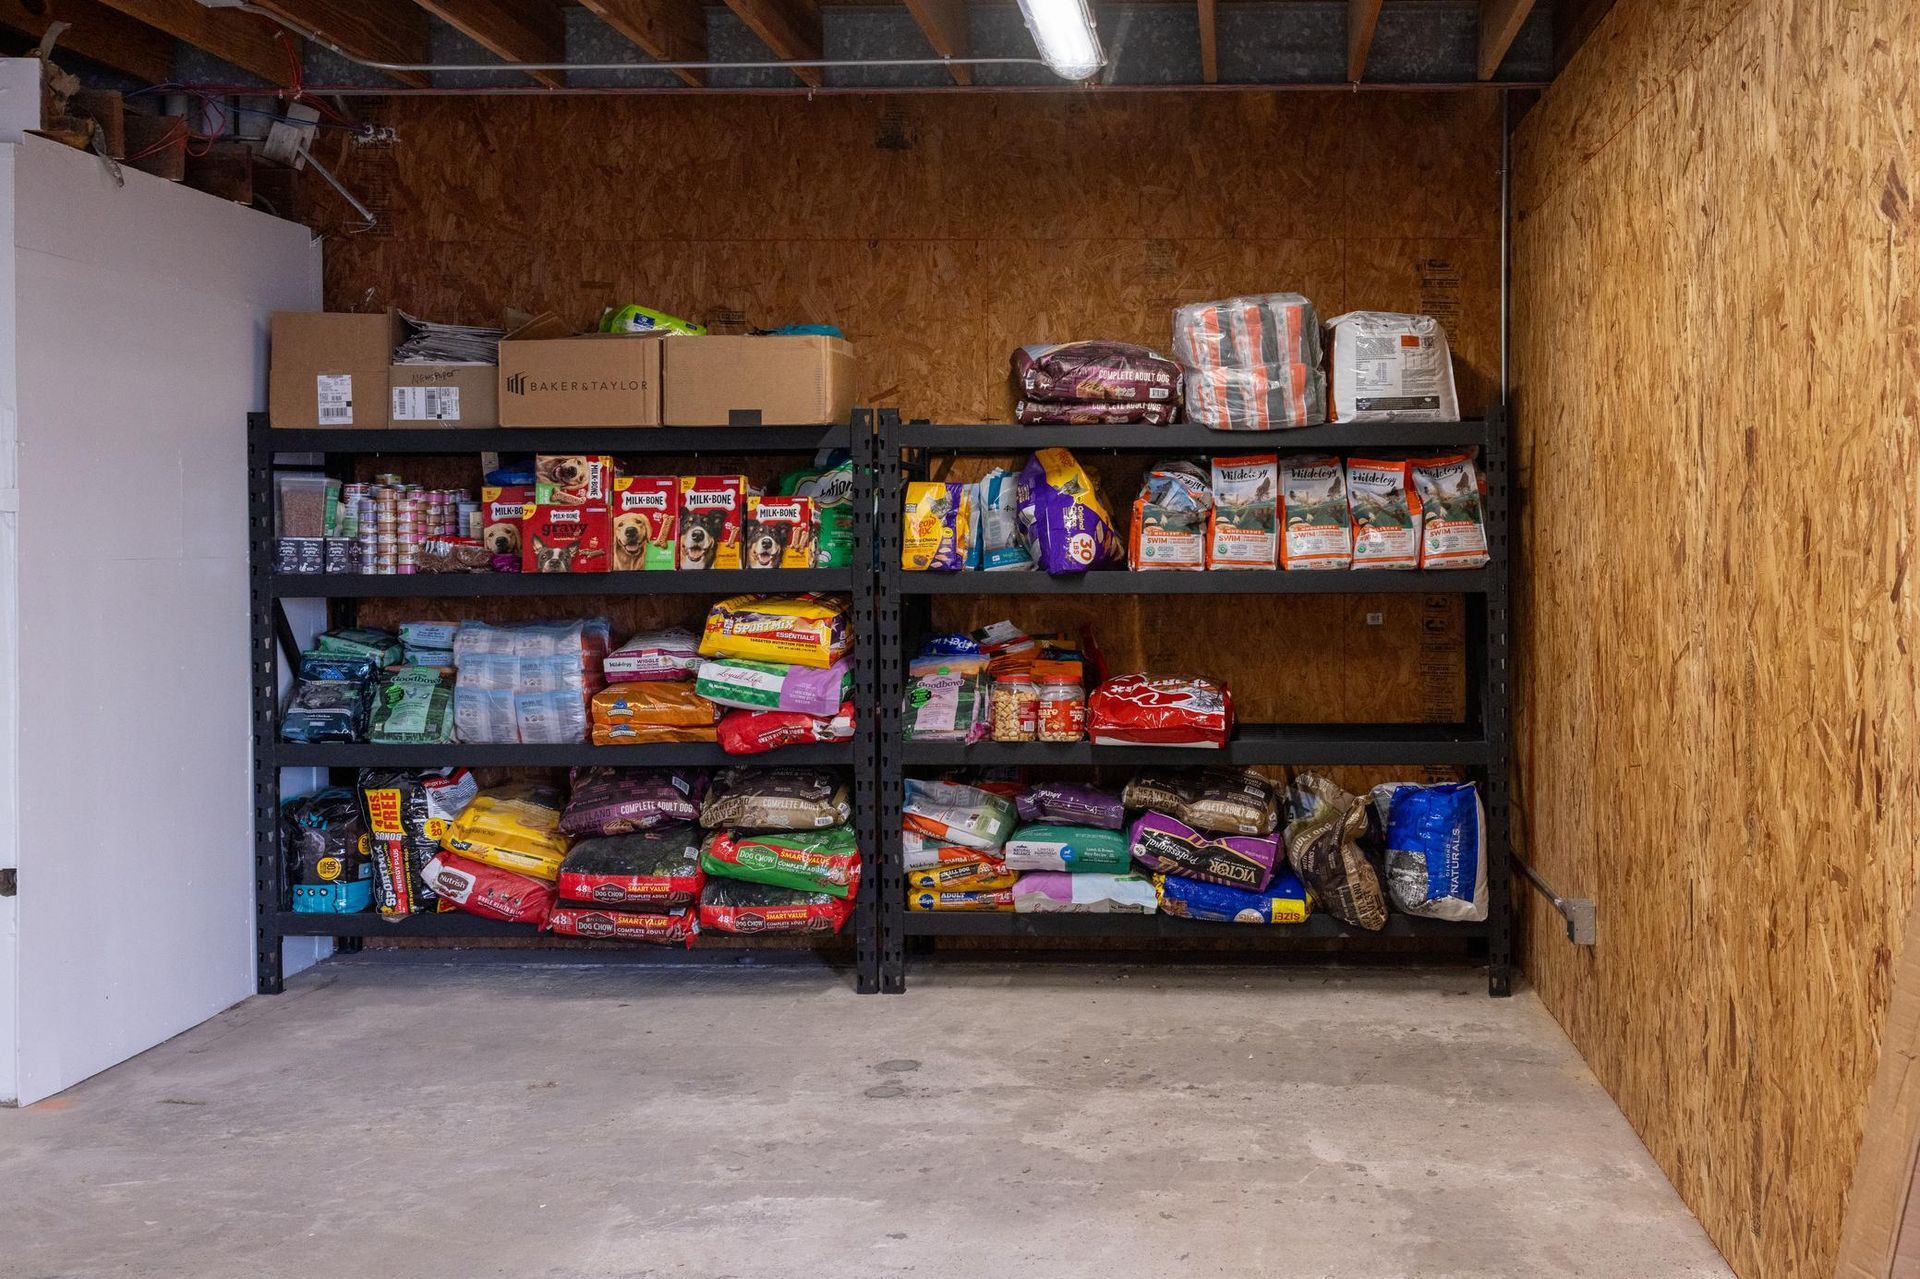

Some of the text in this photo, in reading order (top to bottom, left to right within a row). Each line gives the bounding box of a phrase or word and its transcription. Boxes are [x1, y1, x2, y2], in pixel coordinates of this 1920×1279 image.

[1098, 370, 1170, 384] COMPLETE ADULT DOG
[530, 380, 649, 392] BAKER&TAYLOR
[590, 464, 599, 496] MILK-BONE
[625, 496, 664, 506] MILK-BONE
[689, 494, 732, 505] MILK-BONE
[494, 506, 523, 517] MILK-BO
[552, 512, 579, 520] MILK-BONE
[759, 508, 798, 519] MILK-BONE
[541, 522, 588, 537] gravy
[1080, 538, 1092, 562] 30
[734, 619, 794, 634] SPORTMIX
[776, 632, 815, 641] ESSENTIALS
[620, 800, 693, 815] COMPLETE ADULT DOG
[763, 798, 800, 810] COMPLETE
[381, 792, 400, 830] FREE
[374, 820, 383, 829] 4
[739, 850, 775, 864] DOG CHOW
[1145, 838, 1199, 866] Professional
[1451, 828, 1461, 893] NATURALS
[374, 844, 396, 907] SPORTMIX
[1209, 859, 1256, 883] VICTOR
[439, 873, 467, 889] Nutrish
[607, 890, 625, 898] CHOW
[617, 917, 668, 926] SMART VALUE
[1274, 912, 1300, 921] SIZE!
[578, 922, 613, 931] DOG CHOW
